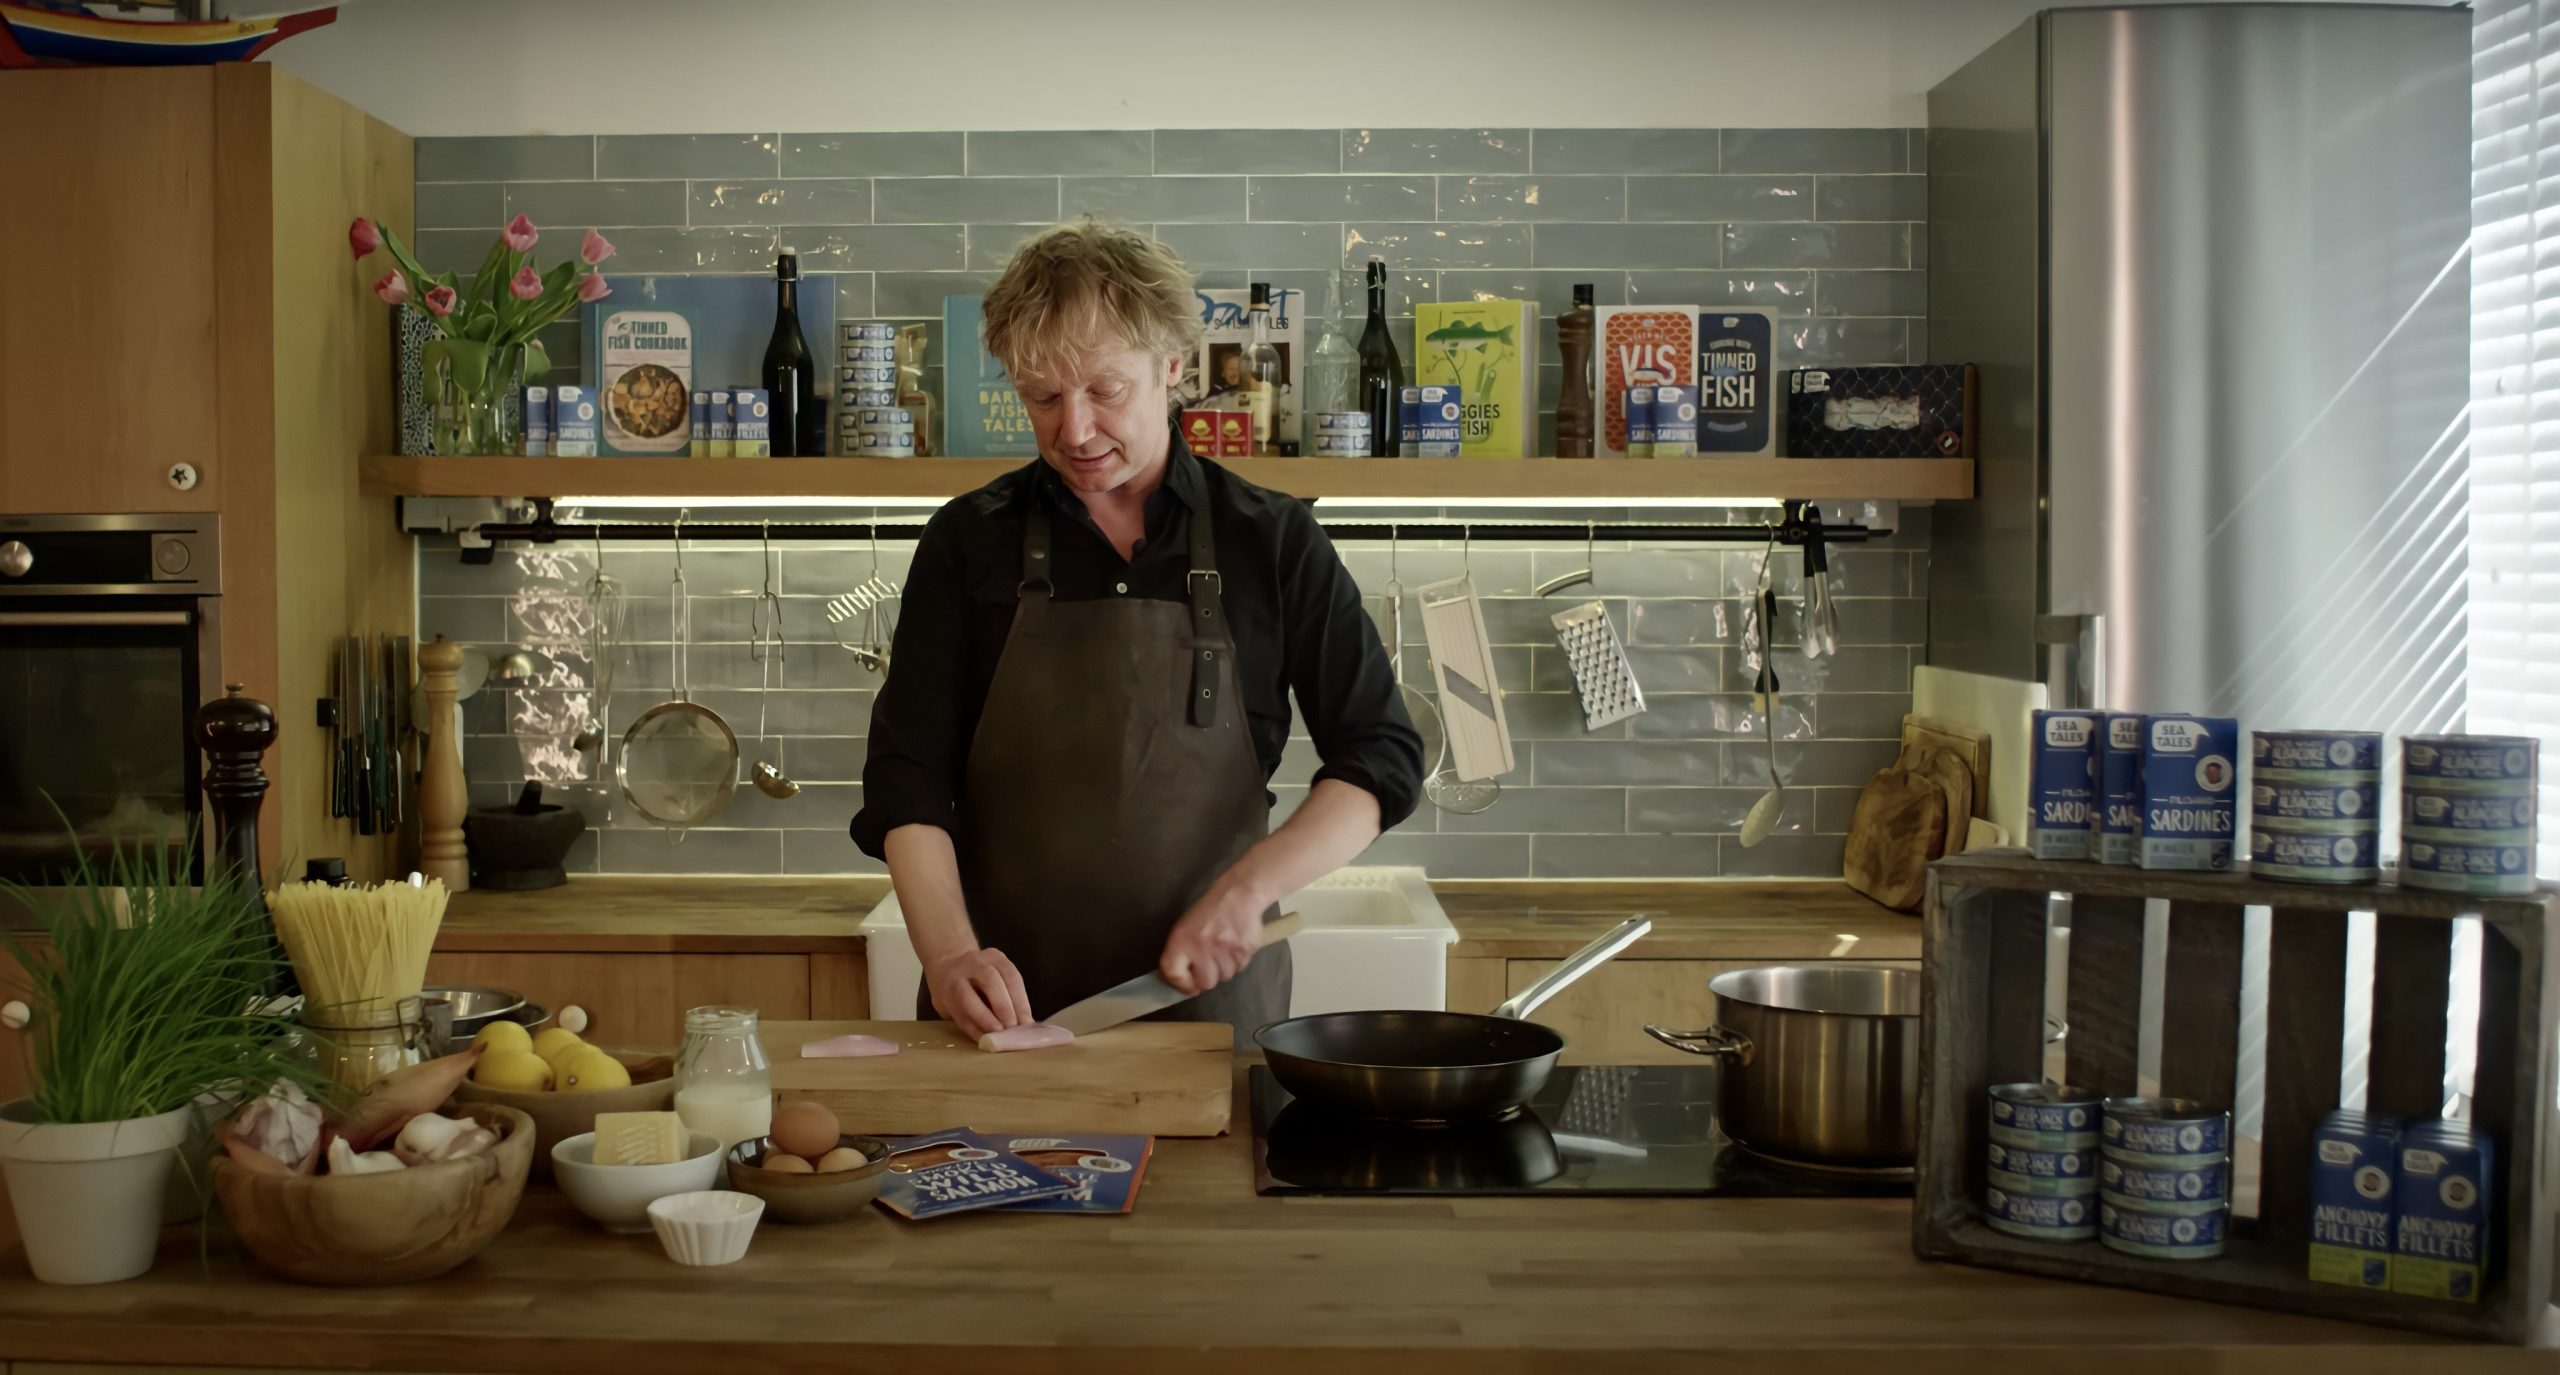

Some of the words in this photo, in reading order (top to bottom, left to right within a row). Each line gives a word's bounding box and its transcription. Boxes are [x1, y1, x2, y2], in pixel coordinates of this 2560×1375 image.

[632, 322, 668, 335] TINNED
[608, 336, 630, 349] FISH
[634, 337, 687, 350] COOKBOOK
[1619, 344, 1677, 385] VIS
[1701, 353, 1757, 372] TINNED
[1701, 375, 1756, 408] FISH
[1461, 403, 1500, 420] GGIES
[2050, 732, 2084, 742] TALES
[2055, 721, 2078, 731] SEA
[2162, 725, 2185, 735] SEA
[2156, 737, 2192, 747] TALES
[2150, 809, 2231, 832] SARDINES
[915, 1168, 1018, 1191] WILD
[929, 1175, 1039, 1201] SALMON
[2315, 1204, 2389, 1228] ANCHOVY
[2399, 1215, 2477, 1240] ANCHOVY
[2314, 1221, 2386, 1247] FILLETS
[2399, 1232, 2474, 1260] FILLETS
